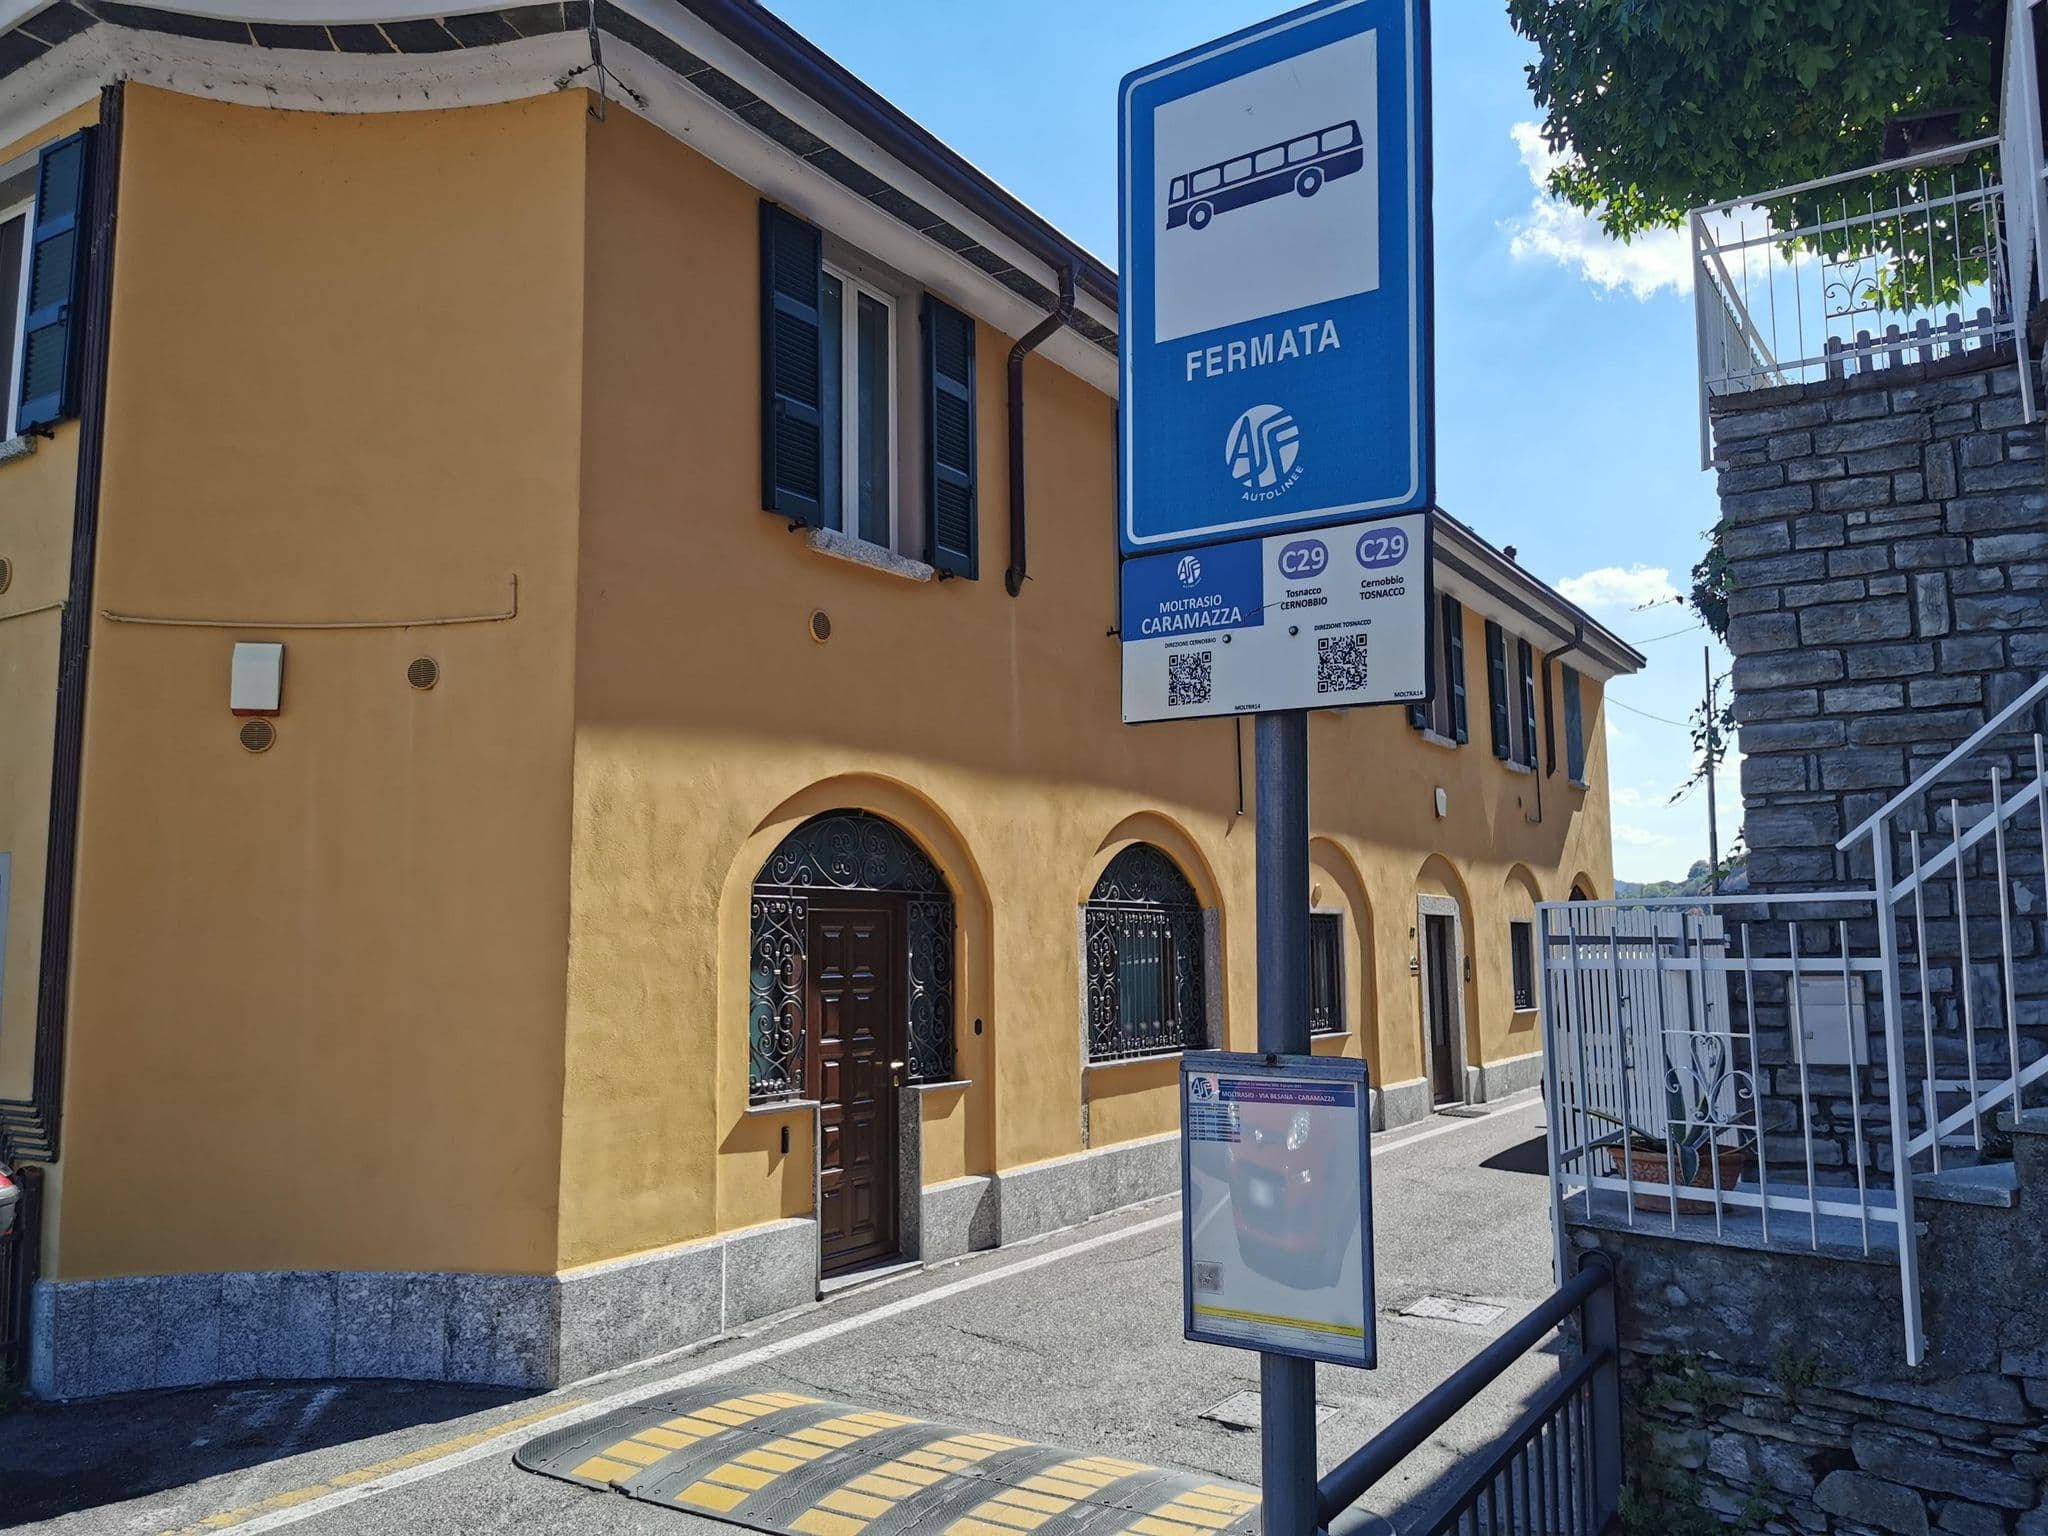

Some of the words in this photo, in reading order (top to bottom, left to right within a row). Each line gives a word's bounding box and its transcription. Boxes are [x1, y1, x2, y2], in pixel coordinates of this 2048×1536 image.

[1186, 319, 1340, 381] FERMATA
[1241, 465, 1304, 502] AUTOLINEE
[1360, 535, 1405, 562] C29
[1282, 547, 1325, 573] C29
[1361, 576, 1404, 588] Cernobbio
[1286, 588, 1322, 598] Tosnacco
[1360, 587, 1406, 600] TOSNACCO
[1159, 594, 1222, 613] MOLTRASIO
[1280, 597, 1328, 610] CERNOBBIO
[1141, 606, 1242, 635] CARAMAZZA
[1314, 623, 1341, 631] DIREZIONE
[1342, 619, 1371, 628] TOSNACCO
[1164, 640, 1189, 648] DIREZIONE
[1189, 637, 1216, 646] CERNOBBIO
[1221, 1090, 1254, 1098] MOLTRASIO
[1270, 1093, 1294, 1101] BESANA
[1298, 1094, 1336, 1103] CARAMAZZA
